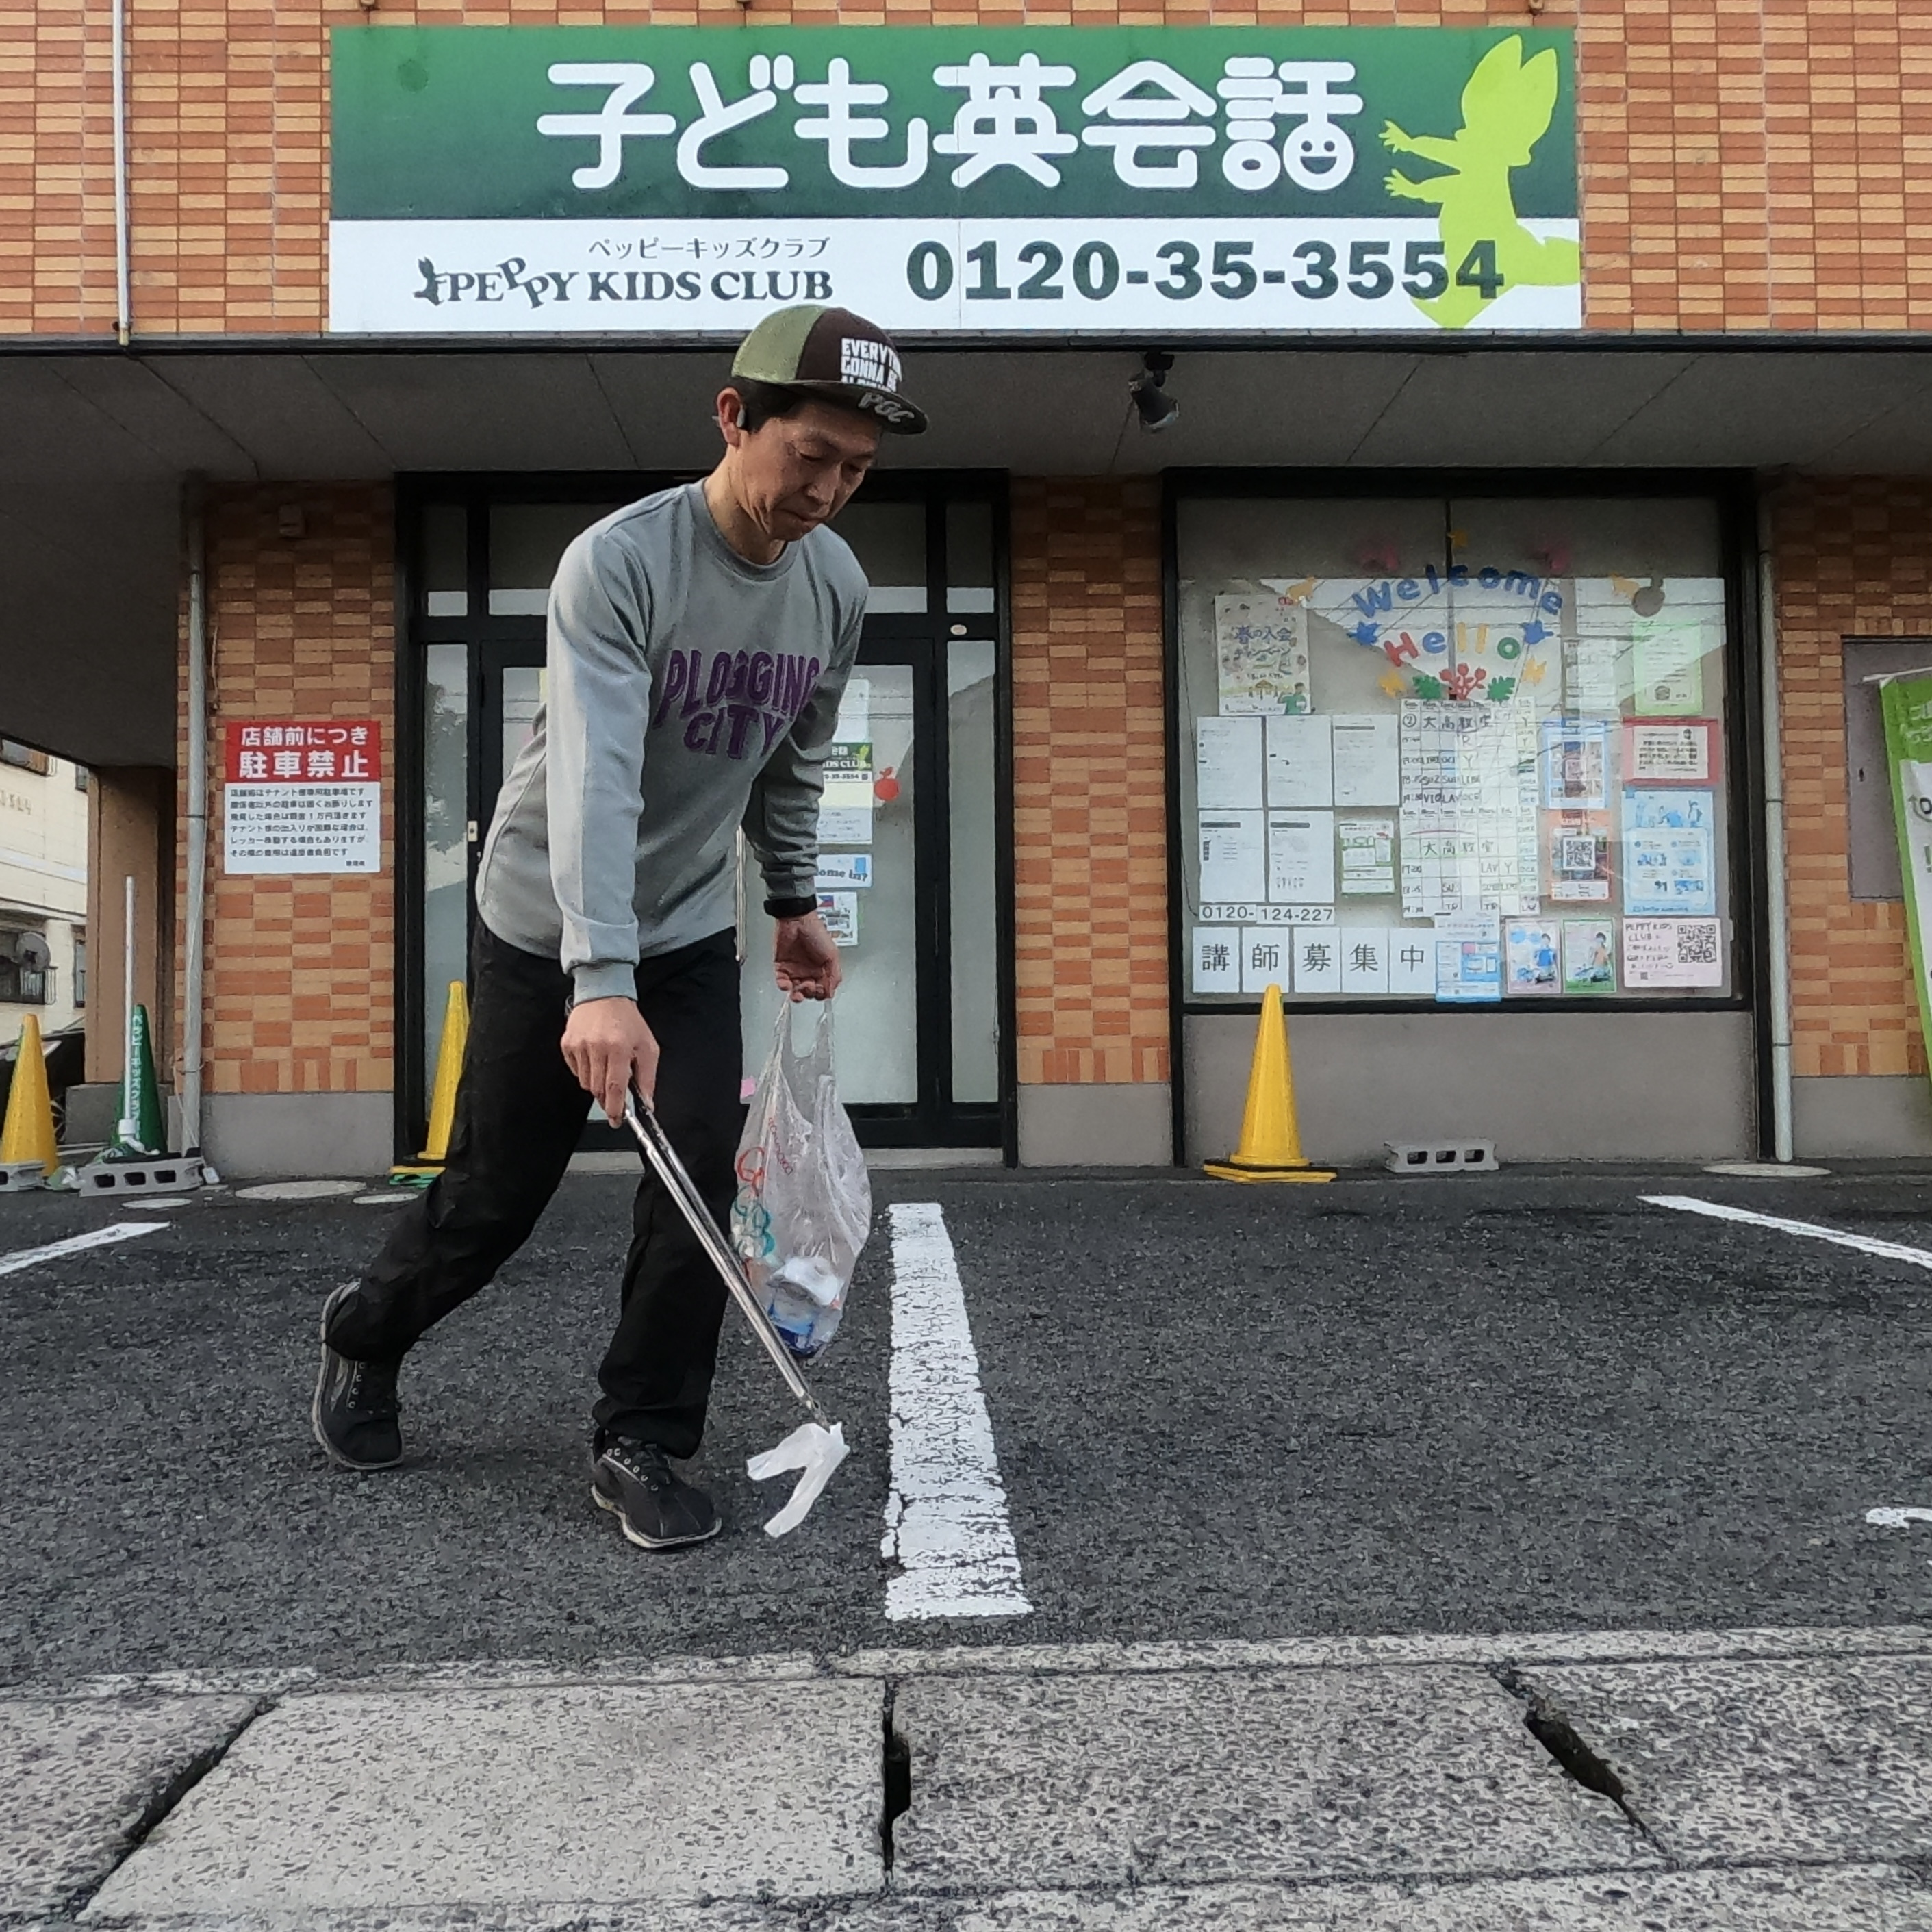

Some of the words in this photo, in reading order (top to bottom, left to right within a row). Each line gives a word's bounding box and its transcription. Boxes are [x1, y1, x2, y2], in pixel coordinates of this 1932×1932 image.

[537, 53, 1362, 191] 子ども英会話
[589, 237, 830, 259] ペッピーキッズクラブ
[906, 240, 1504, 301] 0120-35-3554
[446, 257, 580, 309] PEPPY
[588, 271, 701, 301] KIDS
[711, 270, 833, 301] CLUB
[841, 355, 885, 385] GONNA
[1352, 563, 1563, 618] Welcome
[1383, 621, 1521, 668] Hello
[241, 726, 369, 747] 店舗前につき
[683, 704, 785, 760] CITY
[239, 749, 369, 779] 駐車禁止
[1201, 943, 1425, 973] 講師募集中
